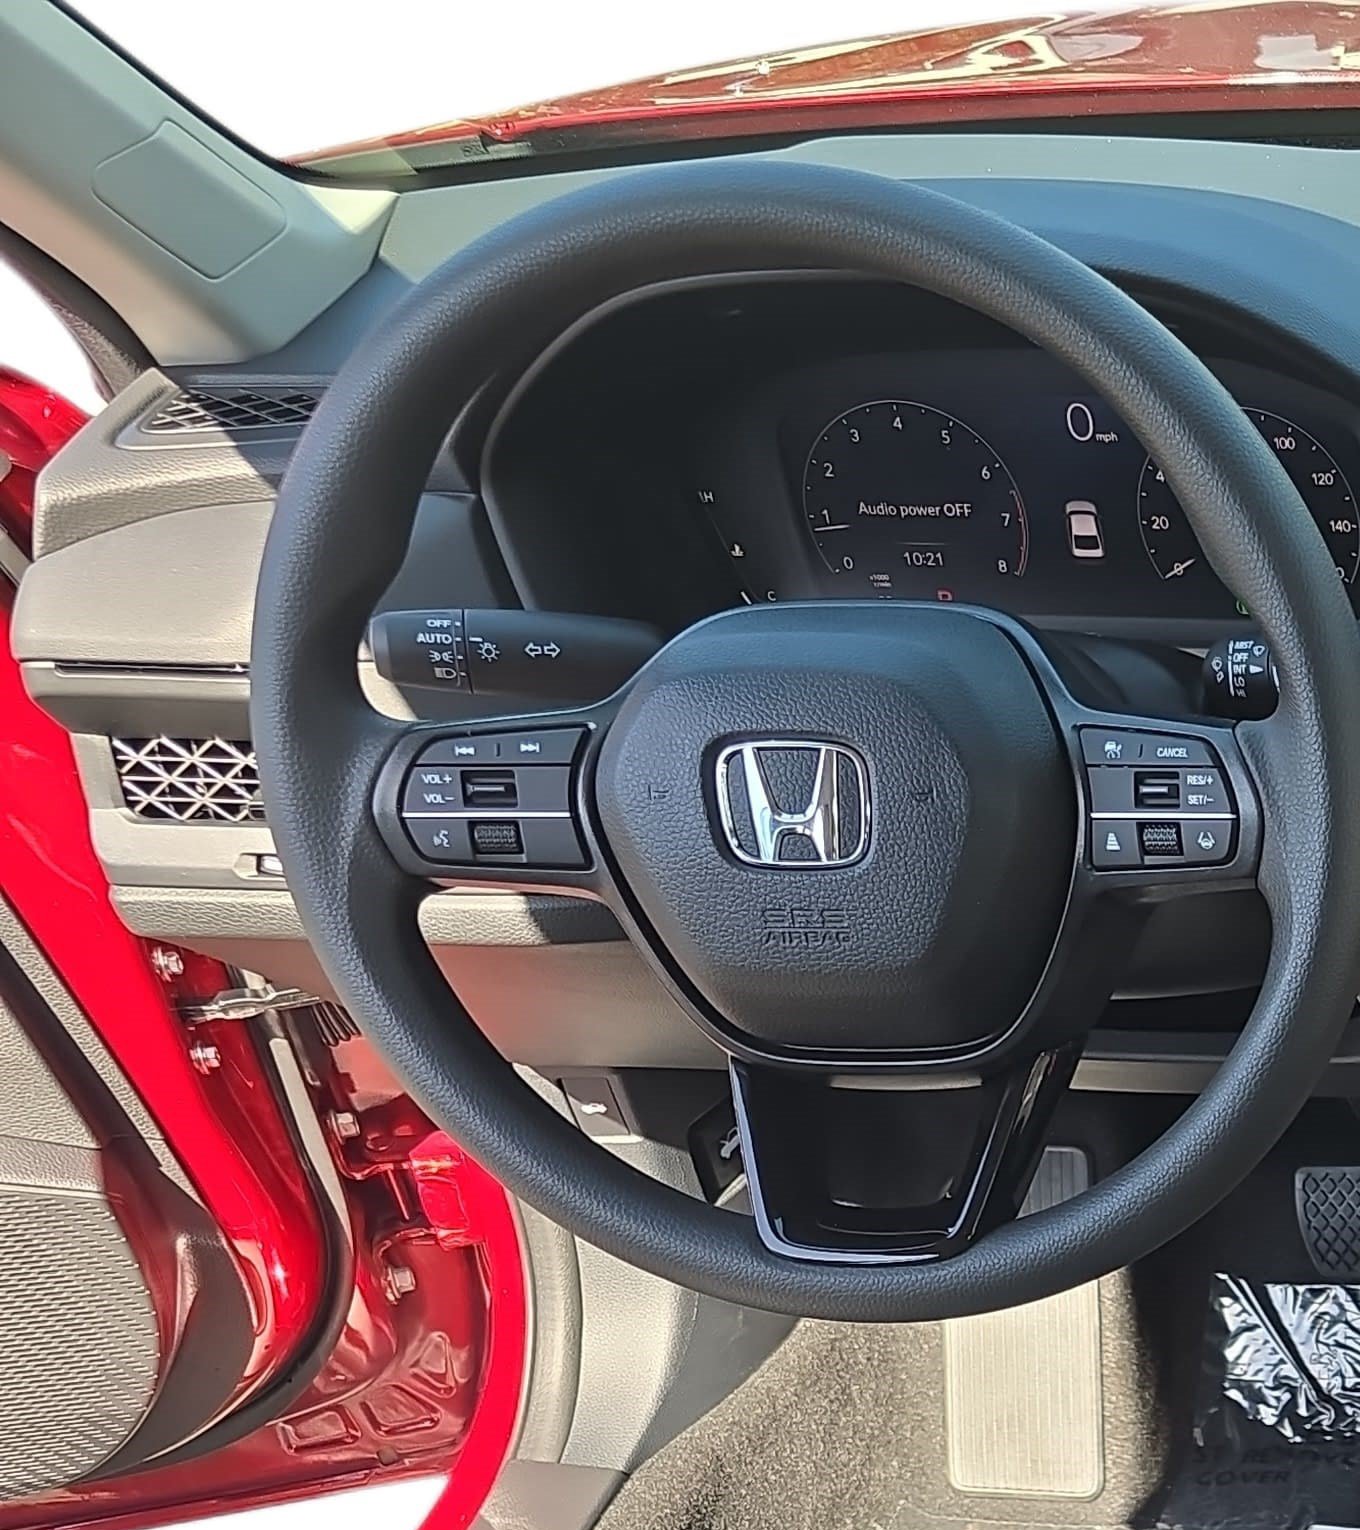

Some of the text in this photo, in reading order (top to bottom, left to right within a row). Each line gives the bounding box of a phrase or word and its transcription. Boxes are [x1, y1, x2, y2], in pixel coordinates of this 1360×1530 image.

[893, 417, 903, 430] 4
[1067, 403, 1118, 443] 0 mph
[850, 429, 860, 442] 3
[941, 431, 951, 444] 5
[1274, 437, 1295, 450] 100
[823, 463, 834, 478] 2
[981, 467, 991, 480] 6
[1312, 473, 1334, 486] 120
[858, 502, 972, 518] Audio power OFF
[821, 509, 831, 525] 1
[1001, 513, 1011, 526] 7
[1151, 516, 1169, 530] 20
[1329, 520, 1350, 533] 140
[843, 557, 853, 569] 0
[903, 552, 944, 566] 10:21
[998, 560, 1008, 573] 8
[767, 591, 777, 601] C
[427, 619, 451, 628] OFF
[417, 632, 452, 644] AUTO
[1233, 653, 1249, 663] OFF
[1157, 747, 1189, 758] CANCEL
